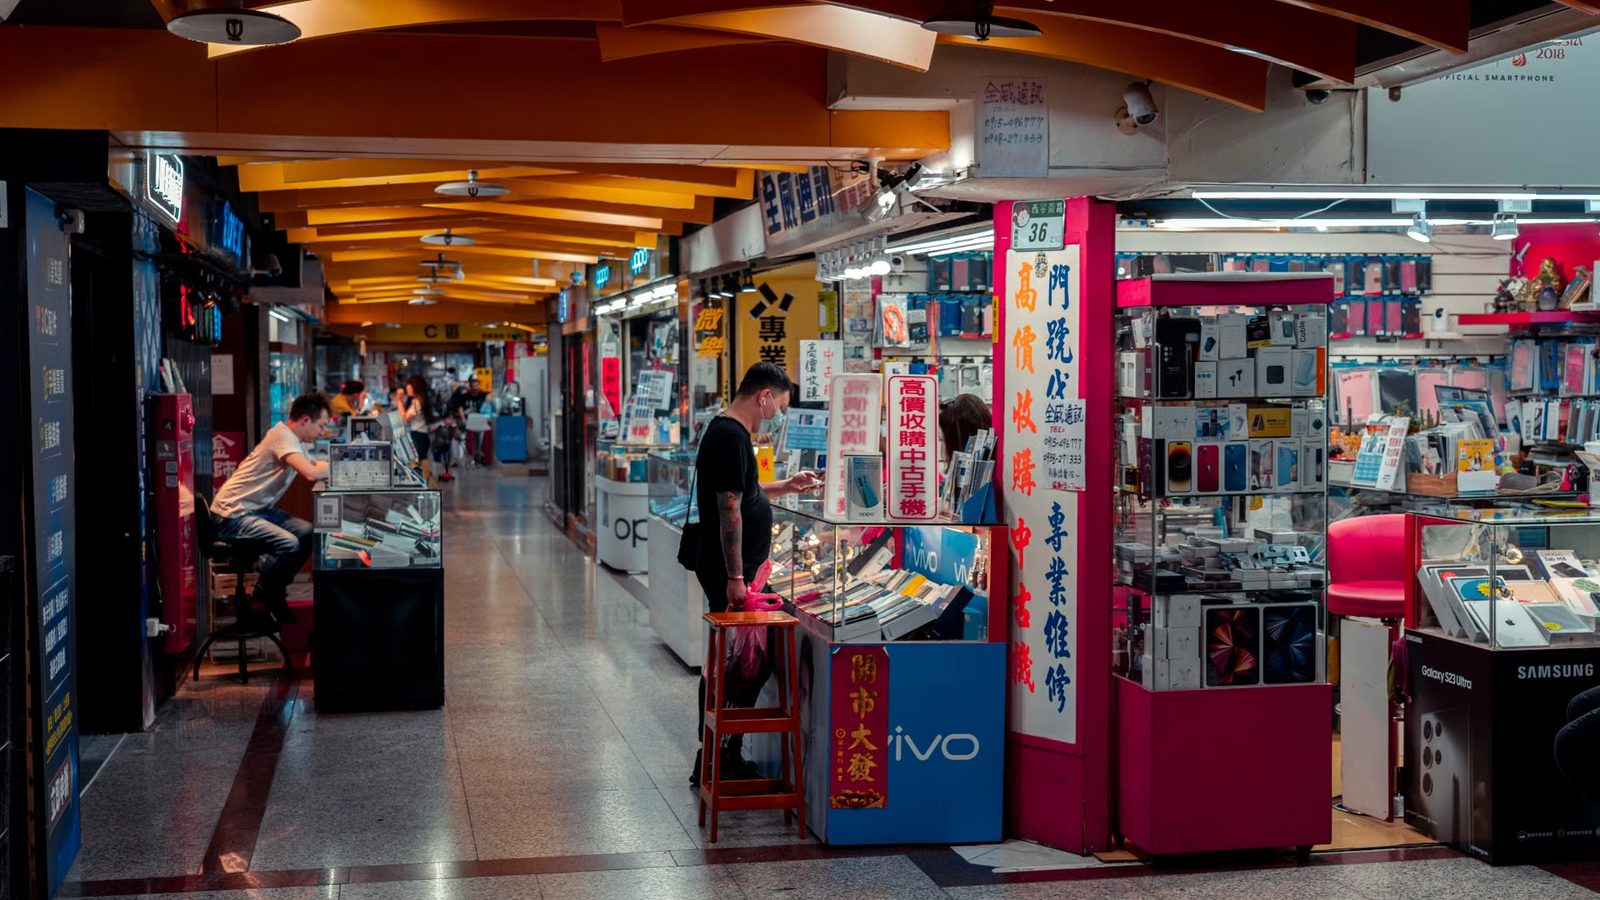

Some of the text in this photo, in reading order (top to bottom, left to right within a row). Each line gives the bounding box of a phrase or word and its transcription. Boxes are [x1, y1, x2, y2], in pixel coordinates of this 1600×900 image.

[1536, 48, 1565, 60] 2018
[1485, 74, 1555, 82] SMARTPHONE
[1028, 222, 1048, 242] 36
[1299, 320, 1307, 343] Cable
[898, 379, 927, 517] 高價收購中古手機
[953, 557, 974, 584] viv
[1421, 664, 1472, 690] Galaxy S23 Ultra
[1517, 663, 1594, 680] SAMSUNG
[847, 653, 878, 782] 開市大發
